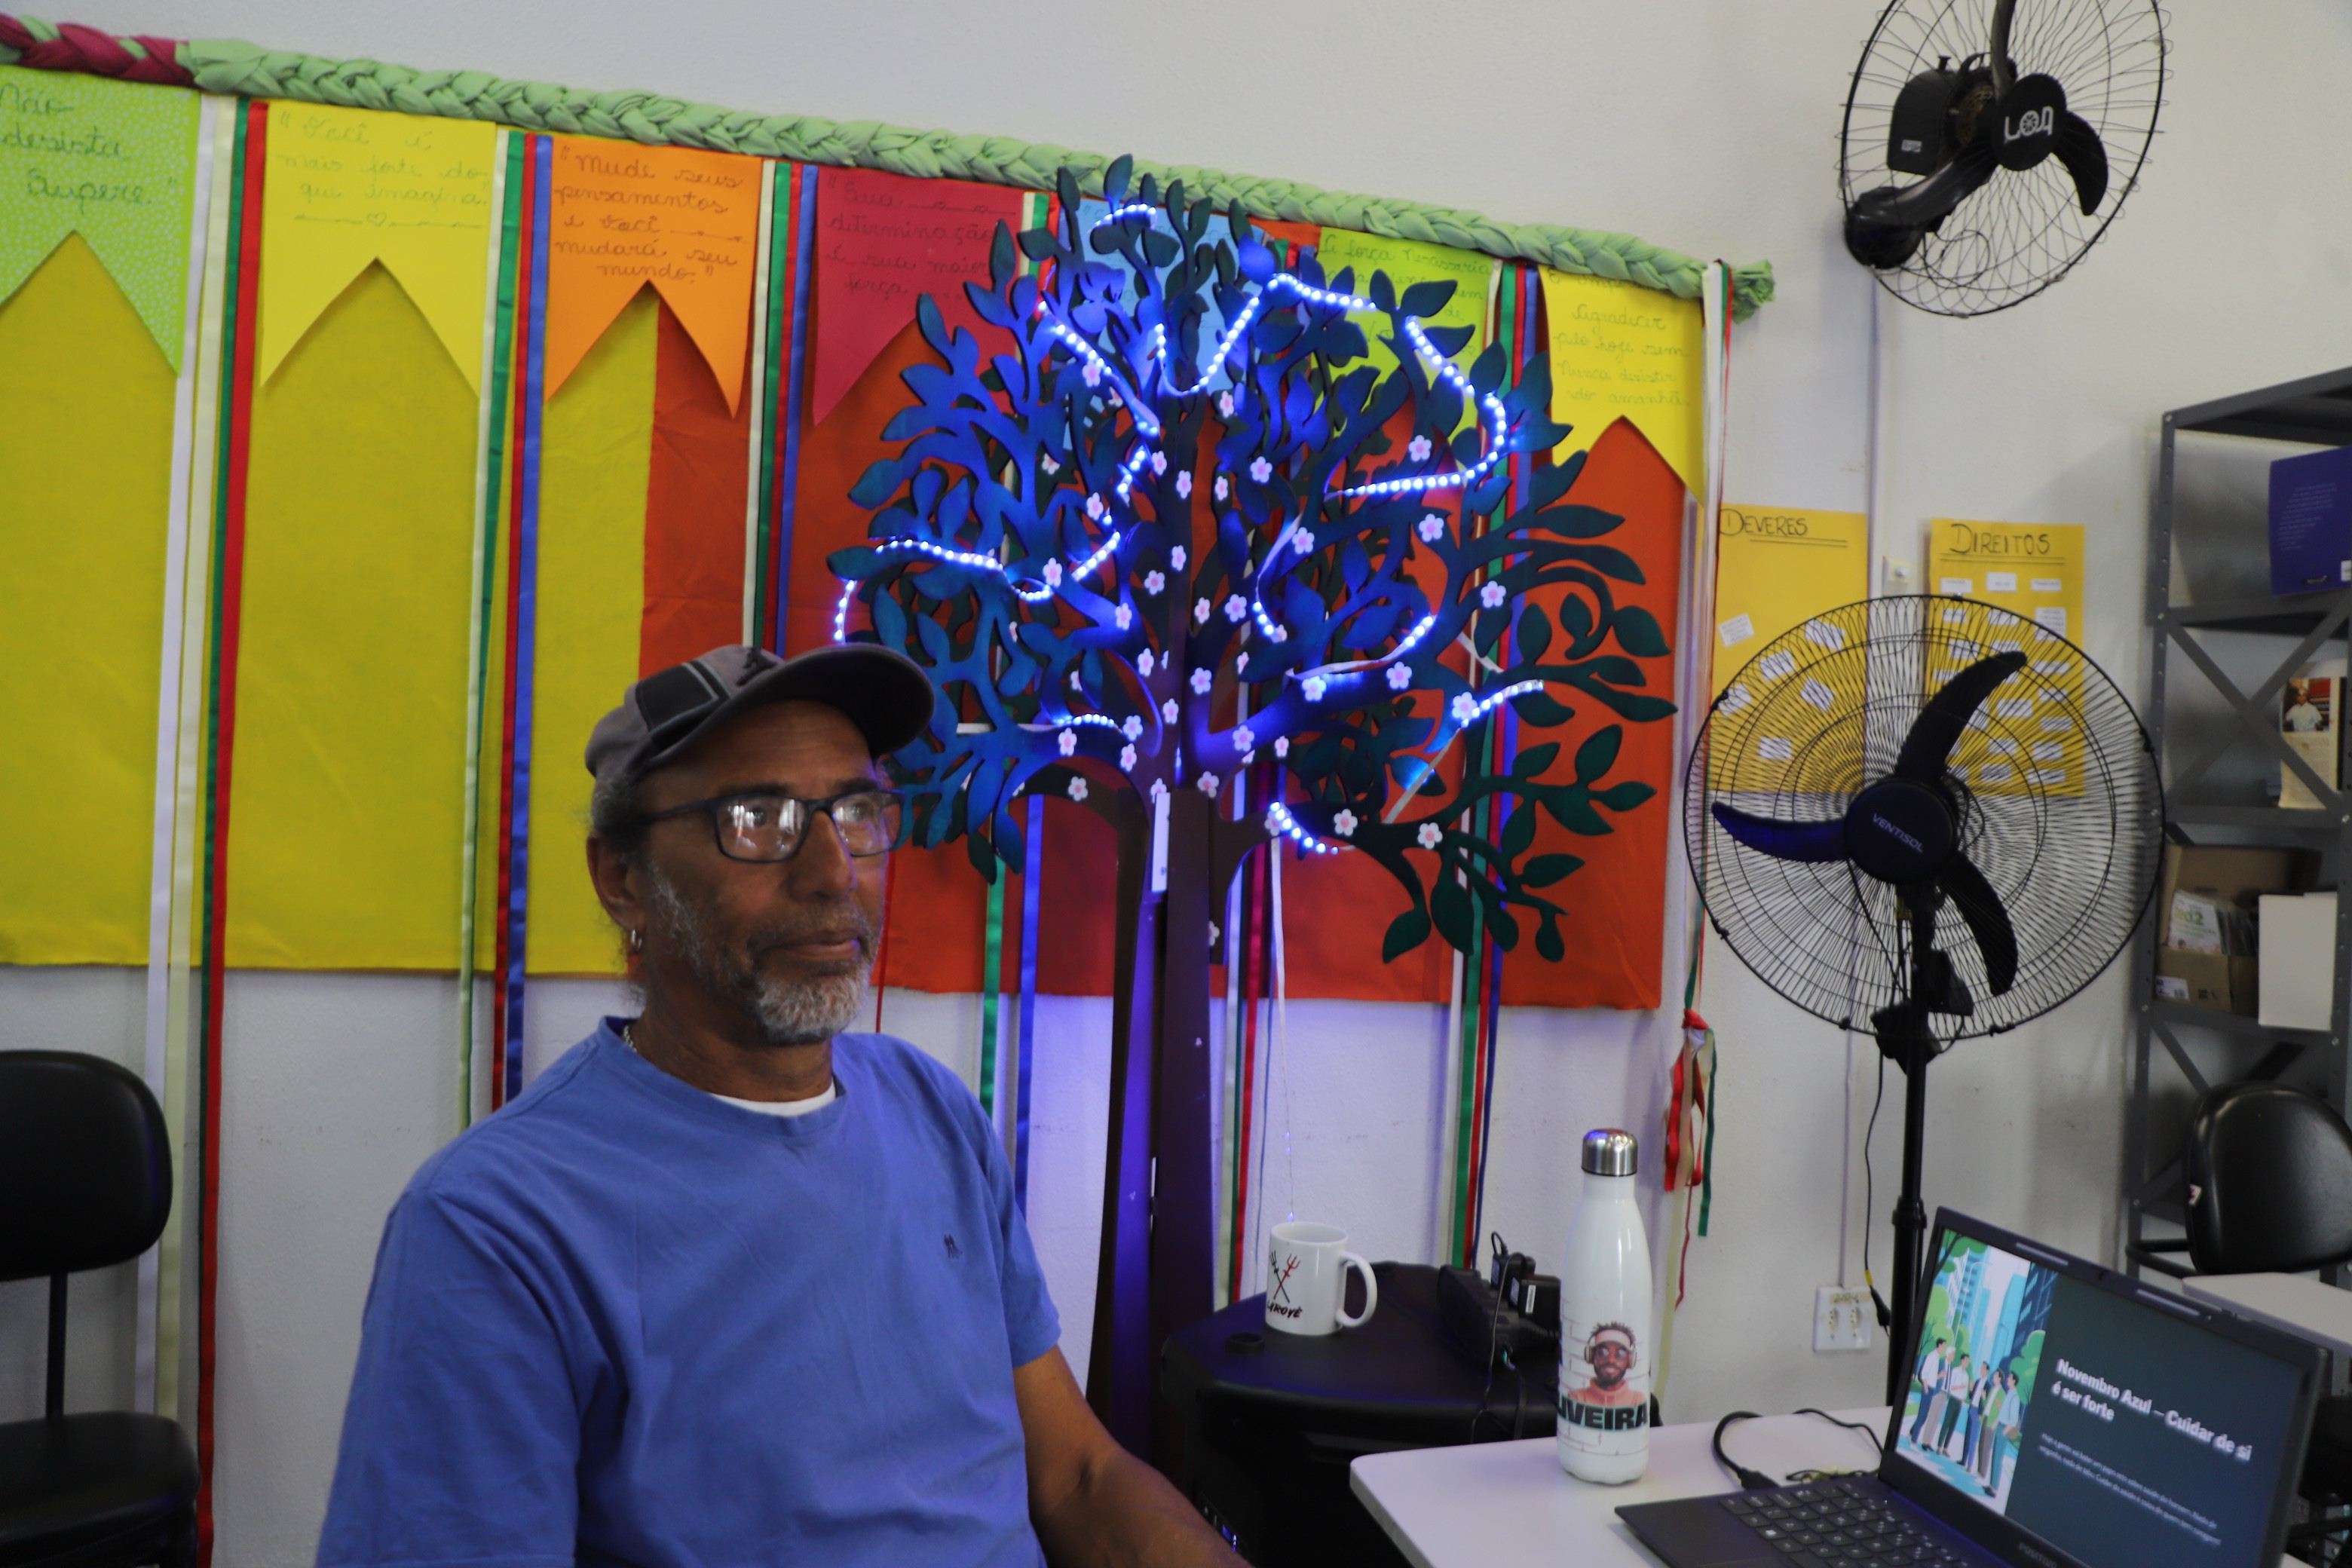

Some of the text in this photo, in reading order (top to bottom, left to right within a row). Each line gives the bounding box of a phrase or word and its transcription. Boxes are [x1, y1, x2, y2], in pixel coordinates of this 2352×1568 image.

[1, 123, 130, 161] desista
[277, 152, 488, 179] mais forte do
[674, 169, 743, 188] seus
[300, 182, 341, 204] que
[553, 185, 729, 214] pensamentos
[599, 214, 660, 233] você
[685, 249, 738, 265] seu
[1344, 239, 1395, 266] força
[1571, 303, 1667, 334] Agradecer
[1594, 336, 1634, 363] hoje
[1720, 508, 1808, 536] DEVERES
[1949, 523, 2050, 555] DIREITOS
[1873, 813, 1923, 853] VENTISOL
[2051, 1381, 2115, 1423] é ser forte
[2056, 1358, 2120, 1400] Novembro
[2118, 1389, 2153, 1415] Azul
[2165, 1410, 2215, 1444] Cuidar
[2213, 1434, 2235, 1454] de
[2234, 1445, 2253, 1463] si
